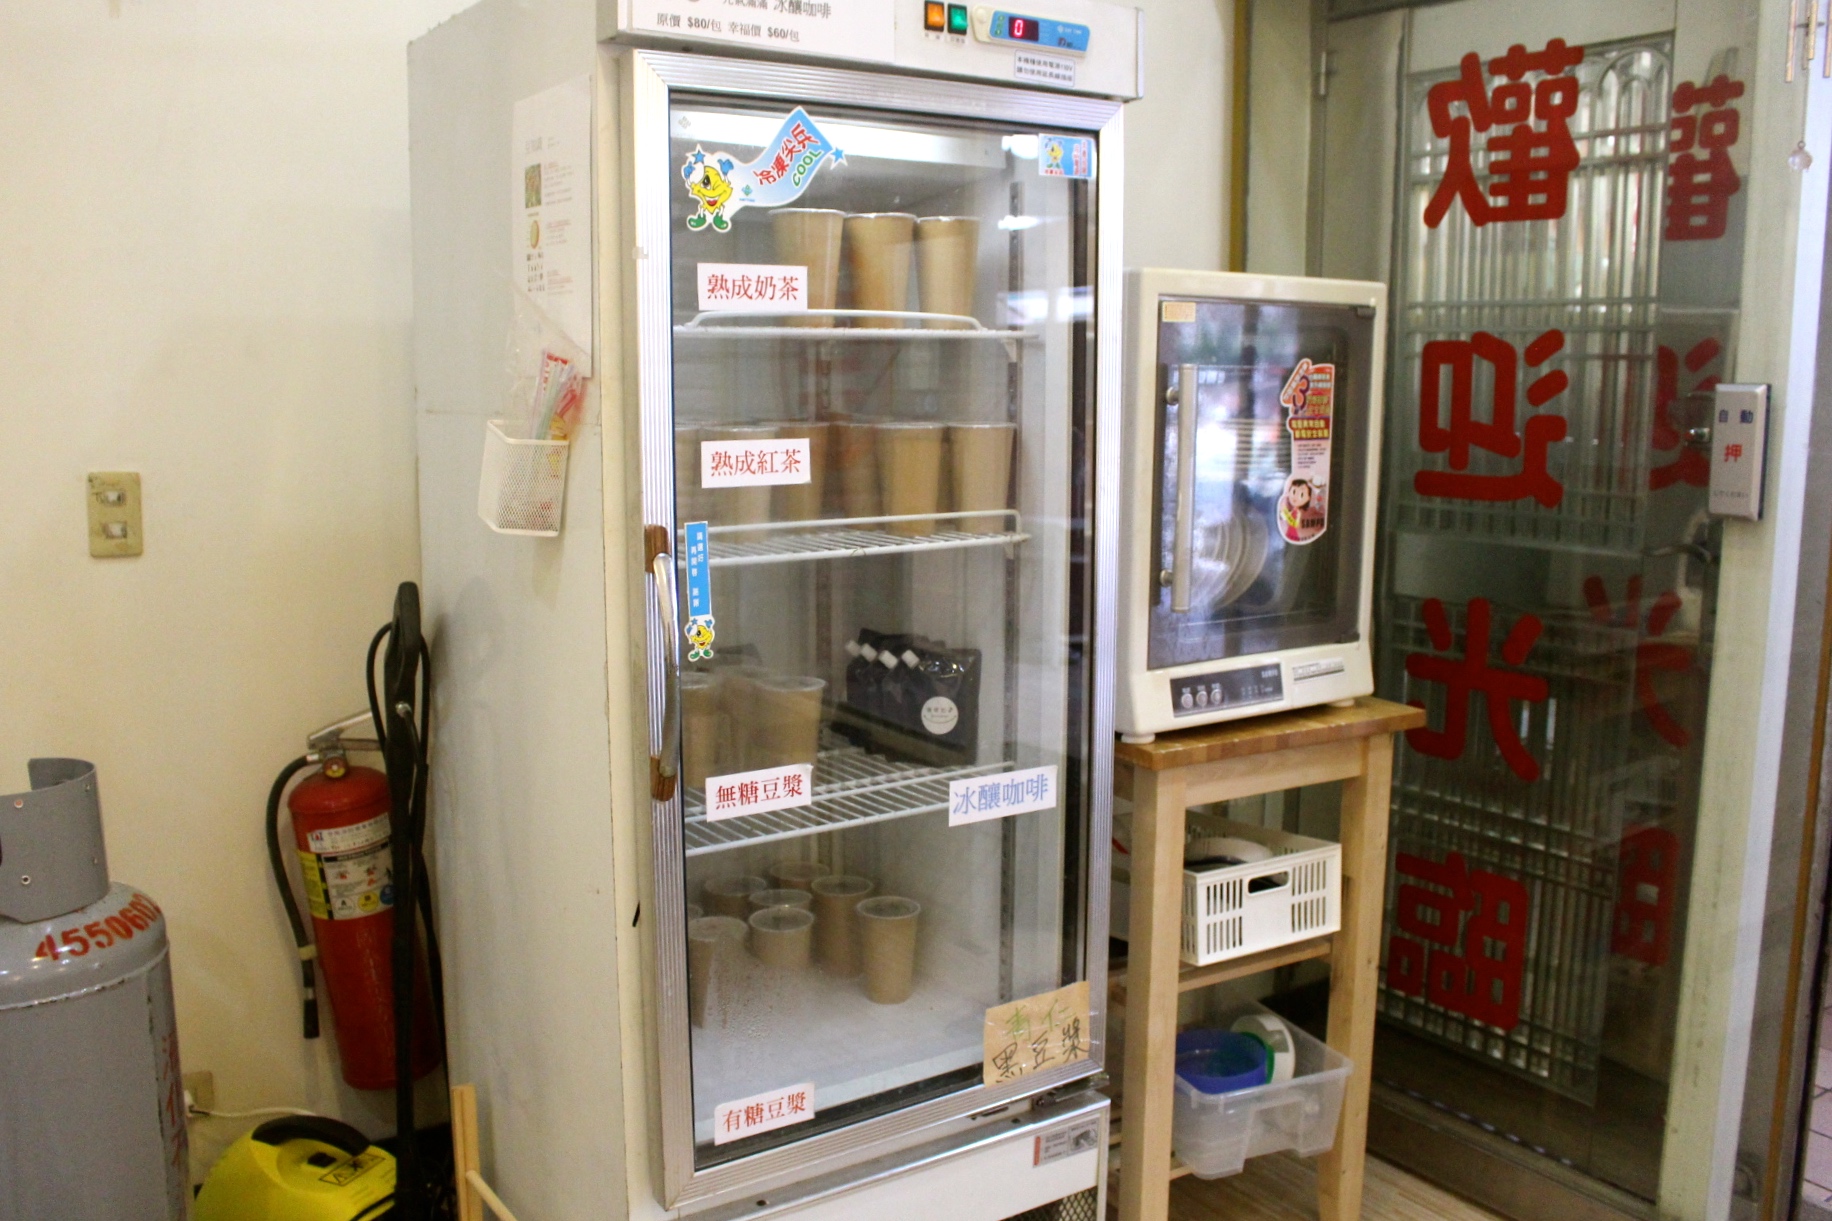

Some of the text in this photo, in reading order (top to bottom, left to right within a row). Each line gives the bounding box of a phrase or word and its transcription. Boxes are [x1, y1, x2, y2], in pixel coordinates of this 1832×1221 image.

[657, 12, 800, 42] 原價 $80/包 幸福價 $60/包
[1013, 19, 1024, 37] 0
[753, 122, 820, 186] 冷凍尖兵
[792, 149, 823, 187] COOL
[707, 274, 799, 301] 熟成奶茶
[711, 448, 801, 477] 熟成紅茶
[1724, 443, 1743, 462] 押
[715, 774, 803, 810] 無糖豆漿
[953, 773, 1048, 815] 冰釀咖啡
[722, 1091, 806, 1132] 有糖豆漿
